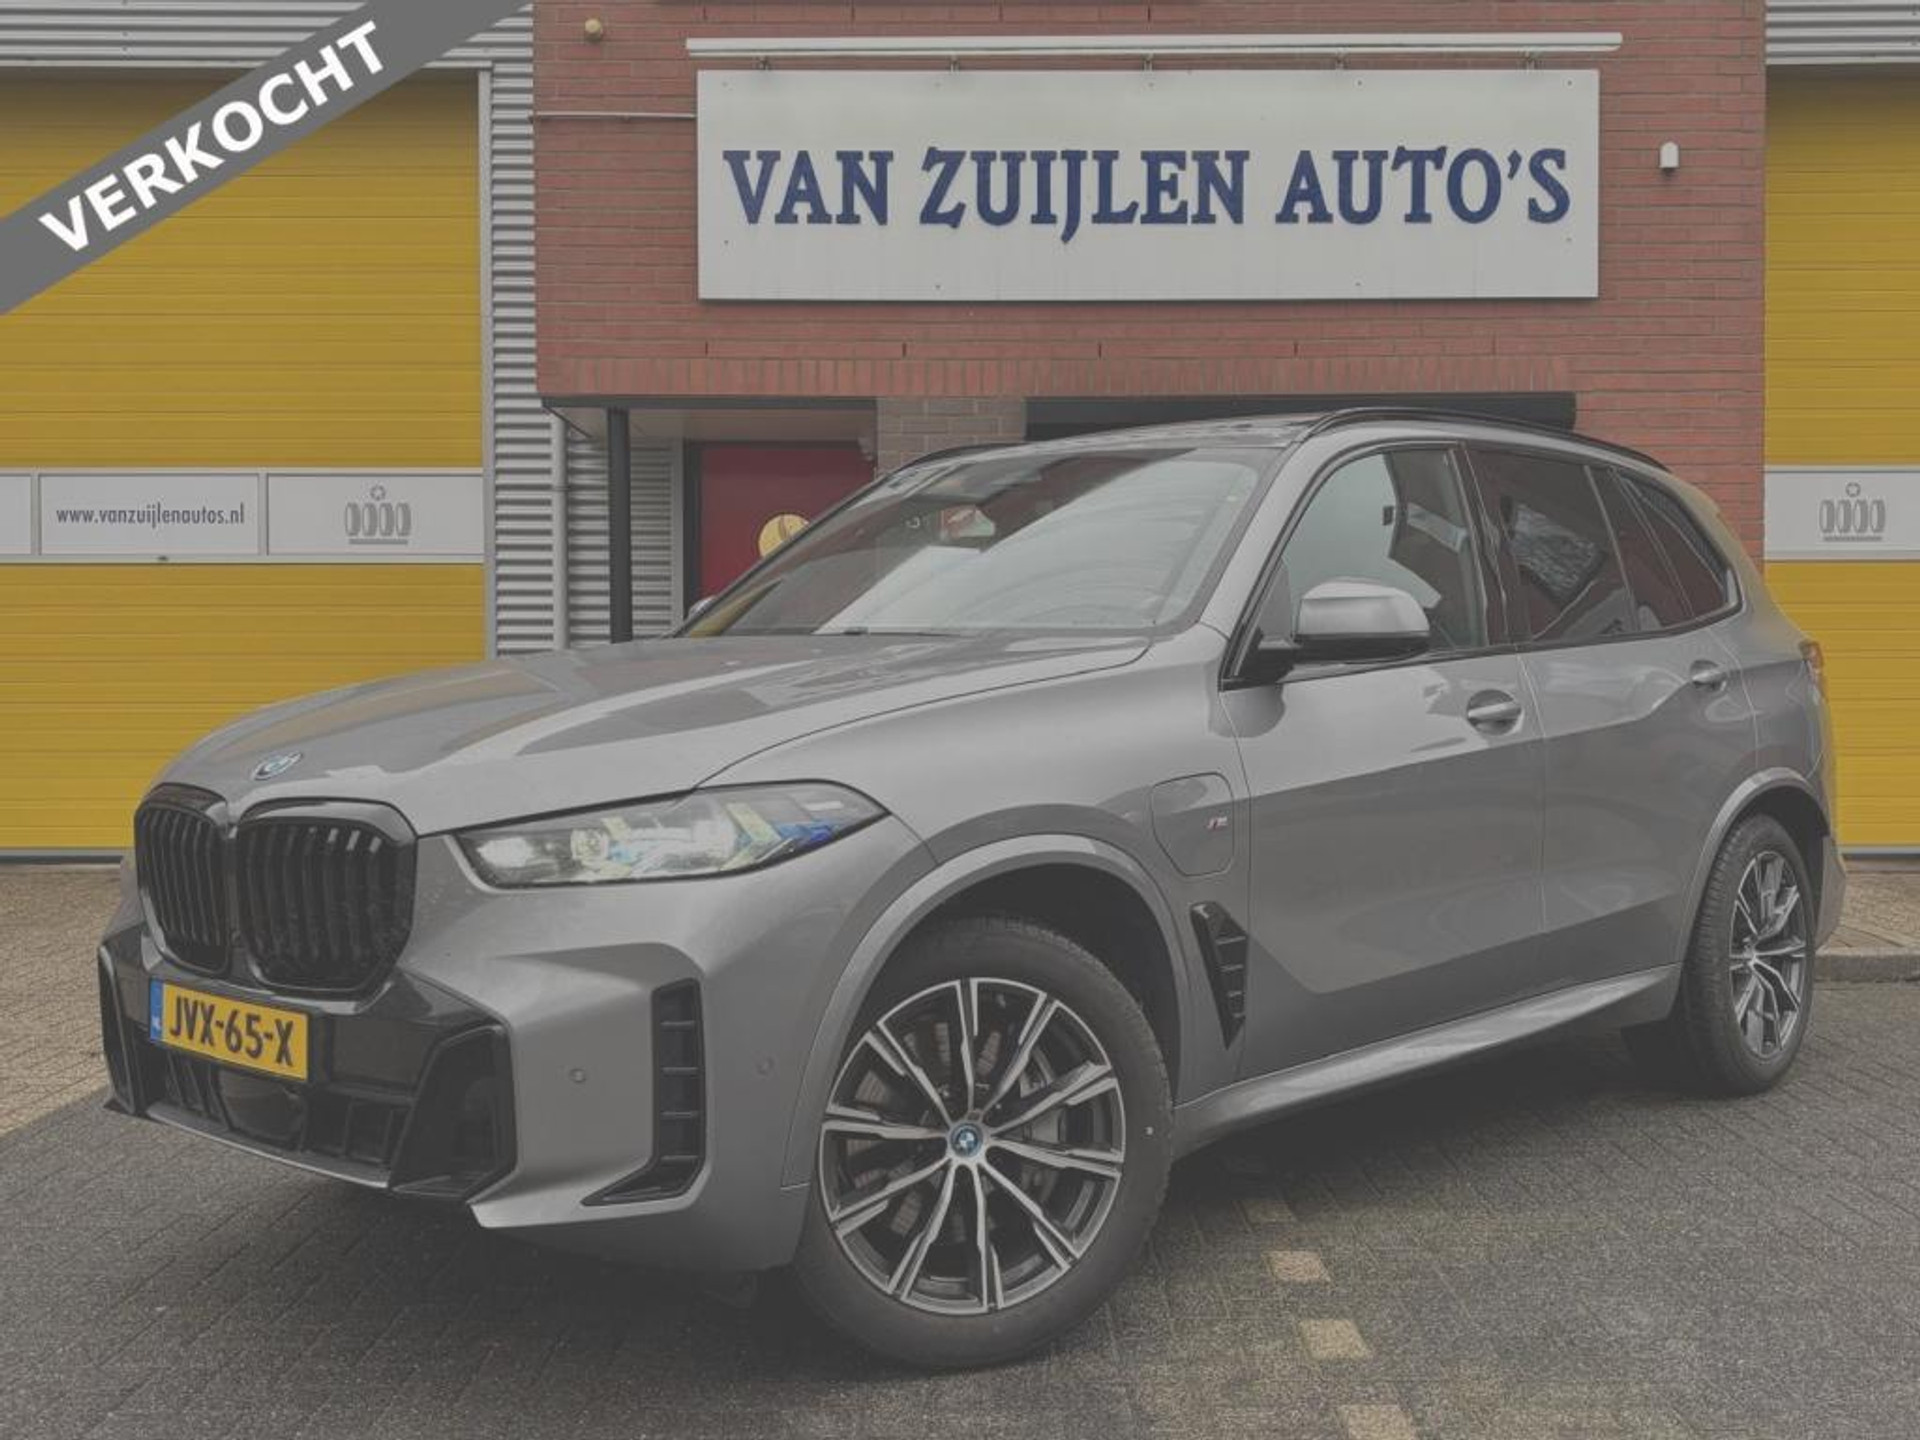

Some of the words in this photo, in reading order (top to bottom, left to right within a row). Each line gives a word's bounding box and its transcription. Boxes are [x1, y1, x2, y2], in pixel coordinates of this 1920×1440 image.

[723, 149, 893, 226] VAN
[919, 146, 1250, 244] ZUIJLEN
[1275, 145, 1571, 226] AUTO'S
[56, 502, 245, 530] www.vanzuijlenautos.nl
[169, 995, 294, 1067] JVX-65-X
